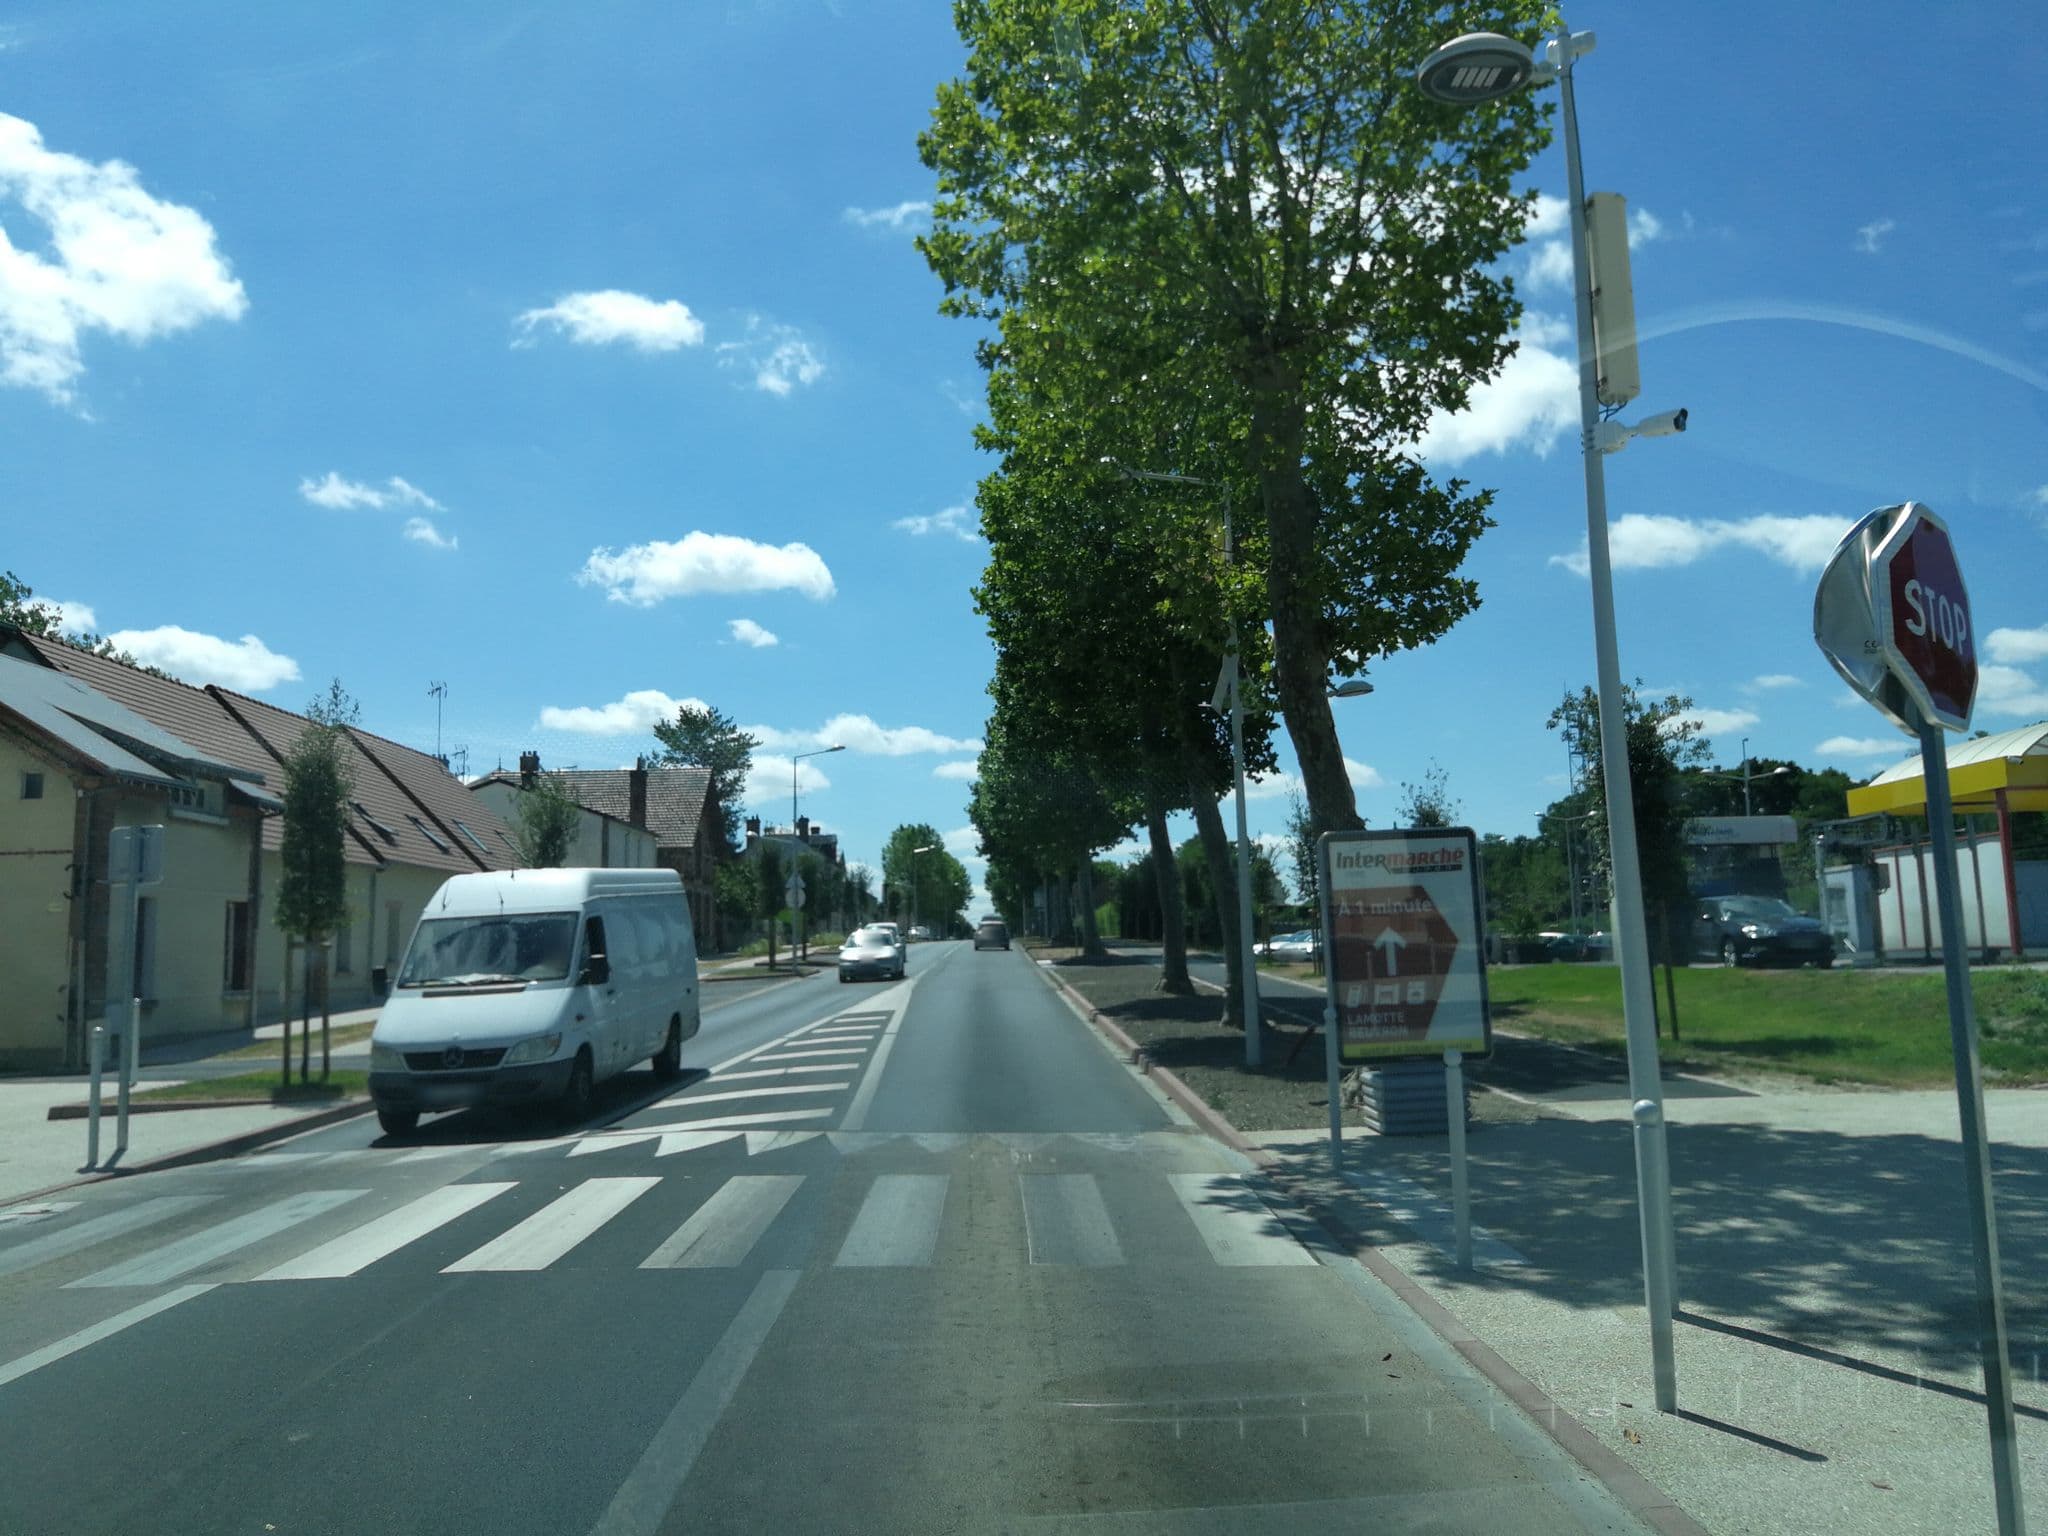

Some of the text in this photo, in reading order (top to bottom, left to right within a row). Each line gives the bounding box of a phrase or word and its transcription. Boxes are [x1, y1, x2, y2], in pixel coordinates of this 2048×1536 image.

[1904, 579, 1967, 654] STOP
[1355, 900, 1364, 914] 1
[1371, 898, 1433, 914] minute
